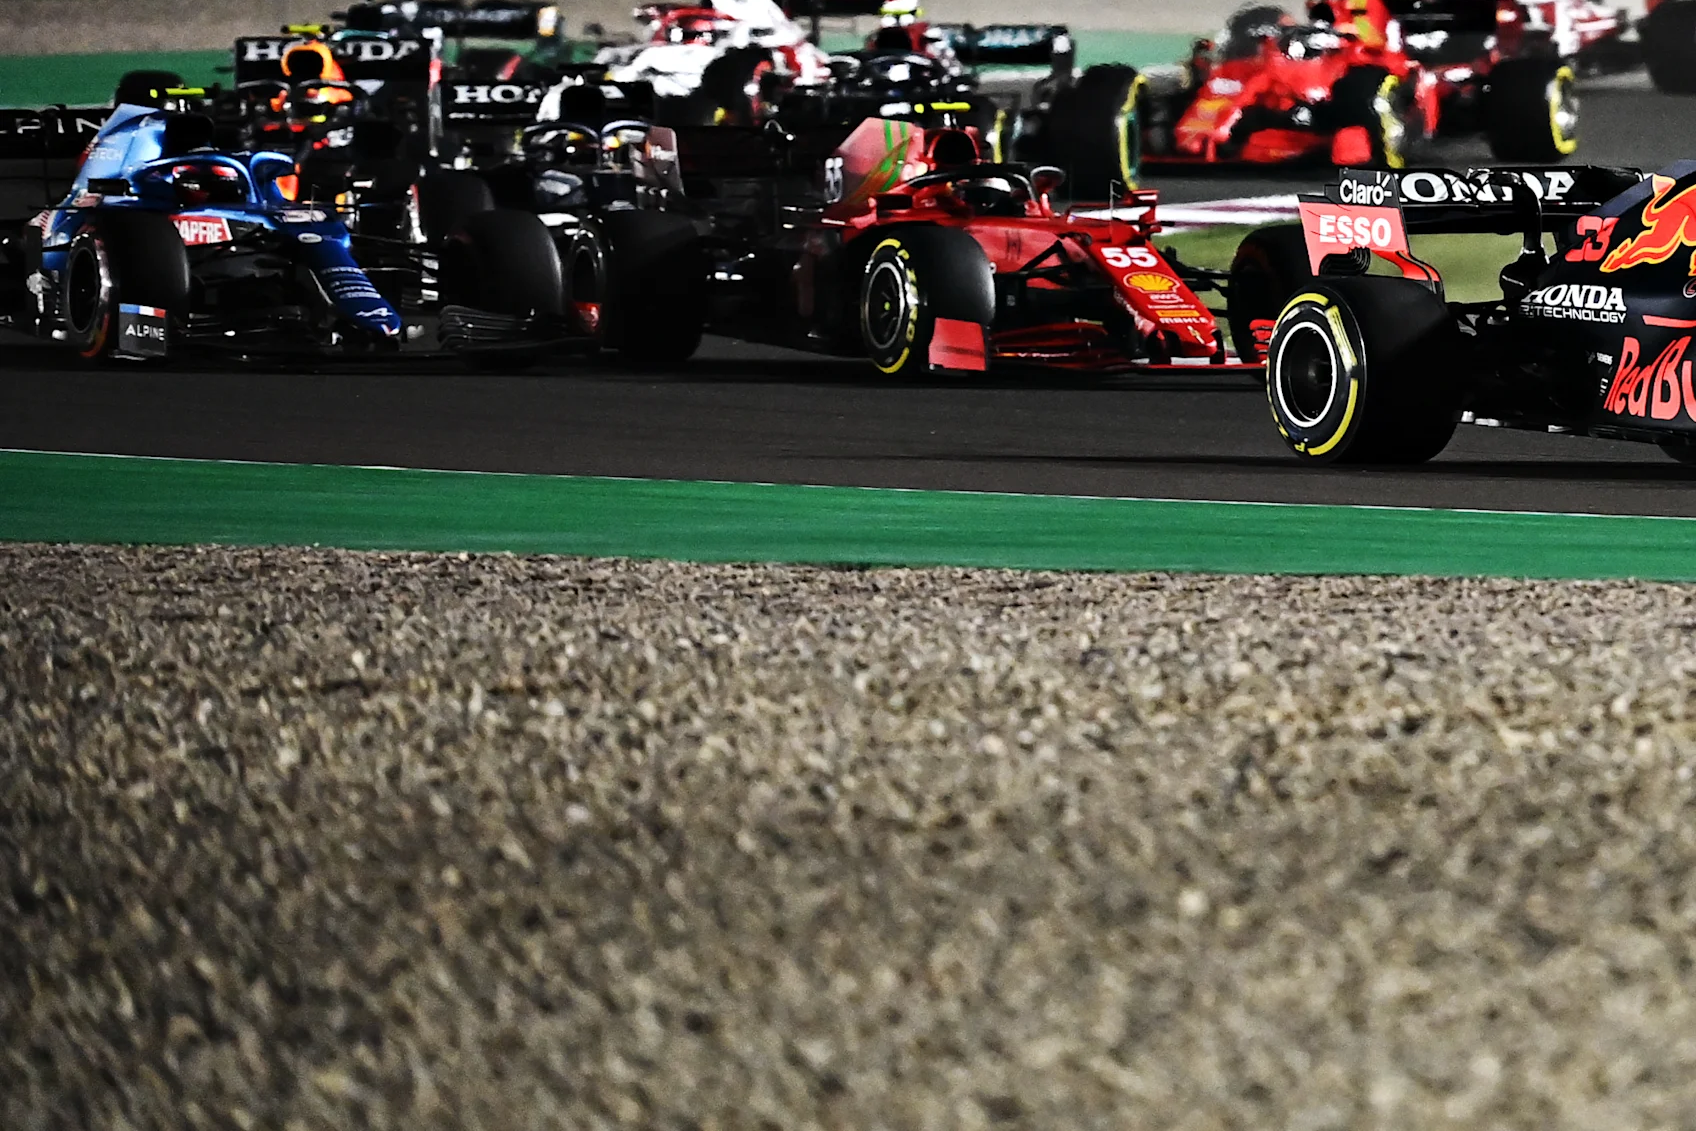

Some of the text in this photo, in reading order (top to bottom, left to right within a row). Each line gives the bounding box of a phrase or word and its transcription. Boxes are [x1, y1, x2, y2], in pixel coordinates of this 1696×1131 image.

[1339, 177, 1386, 205] Claro
[1319, 215, 1391, 247] ESSO
[1101, 247, 1158, 268] 55
[1521, 284, 1627, 311] HONDA
[125, 324, 165, 340] ALPINE
